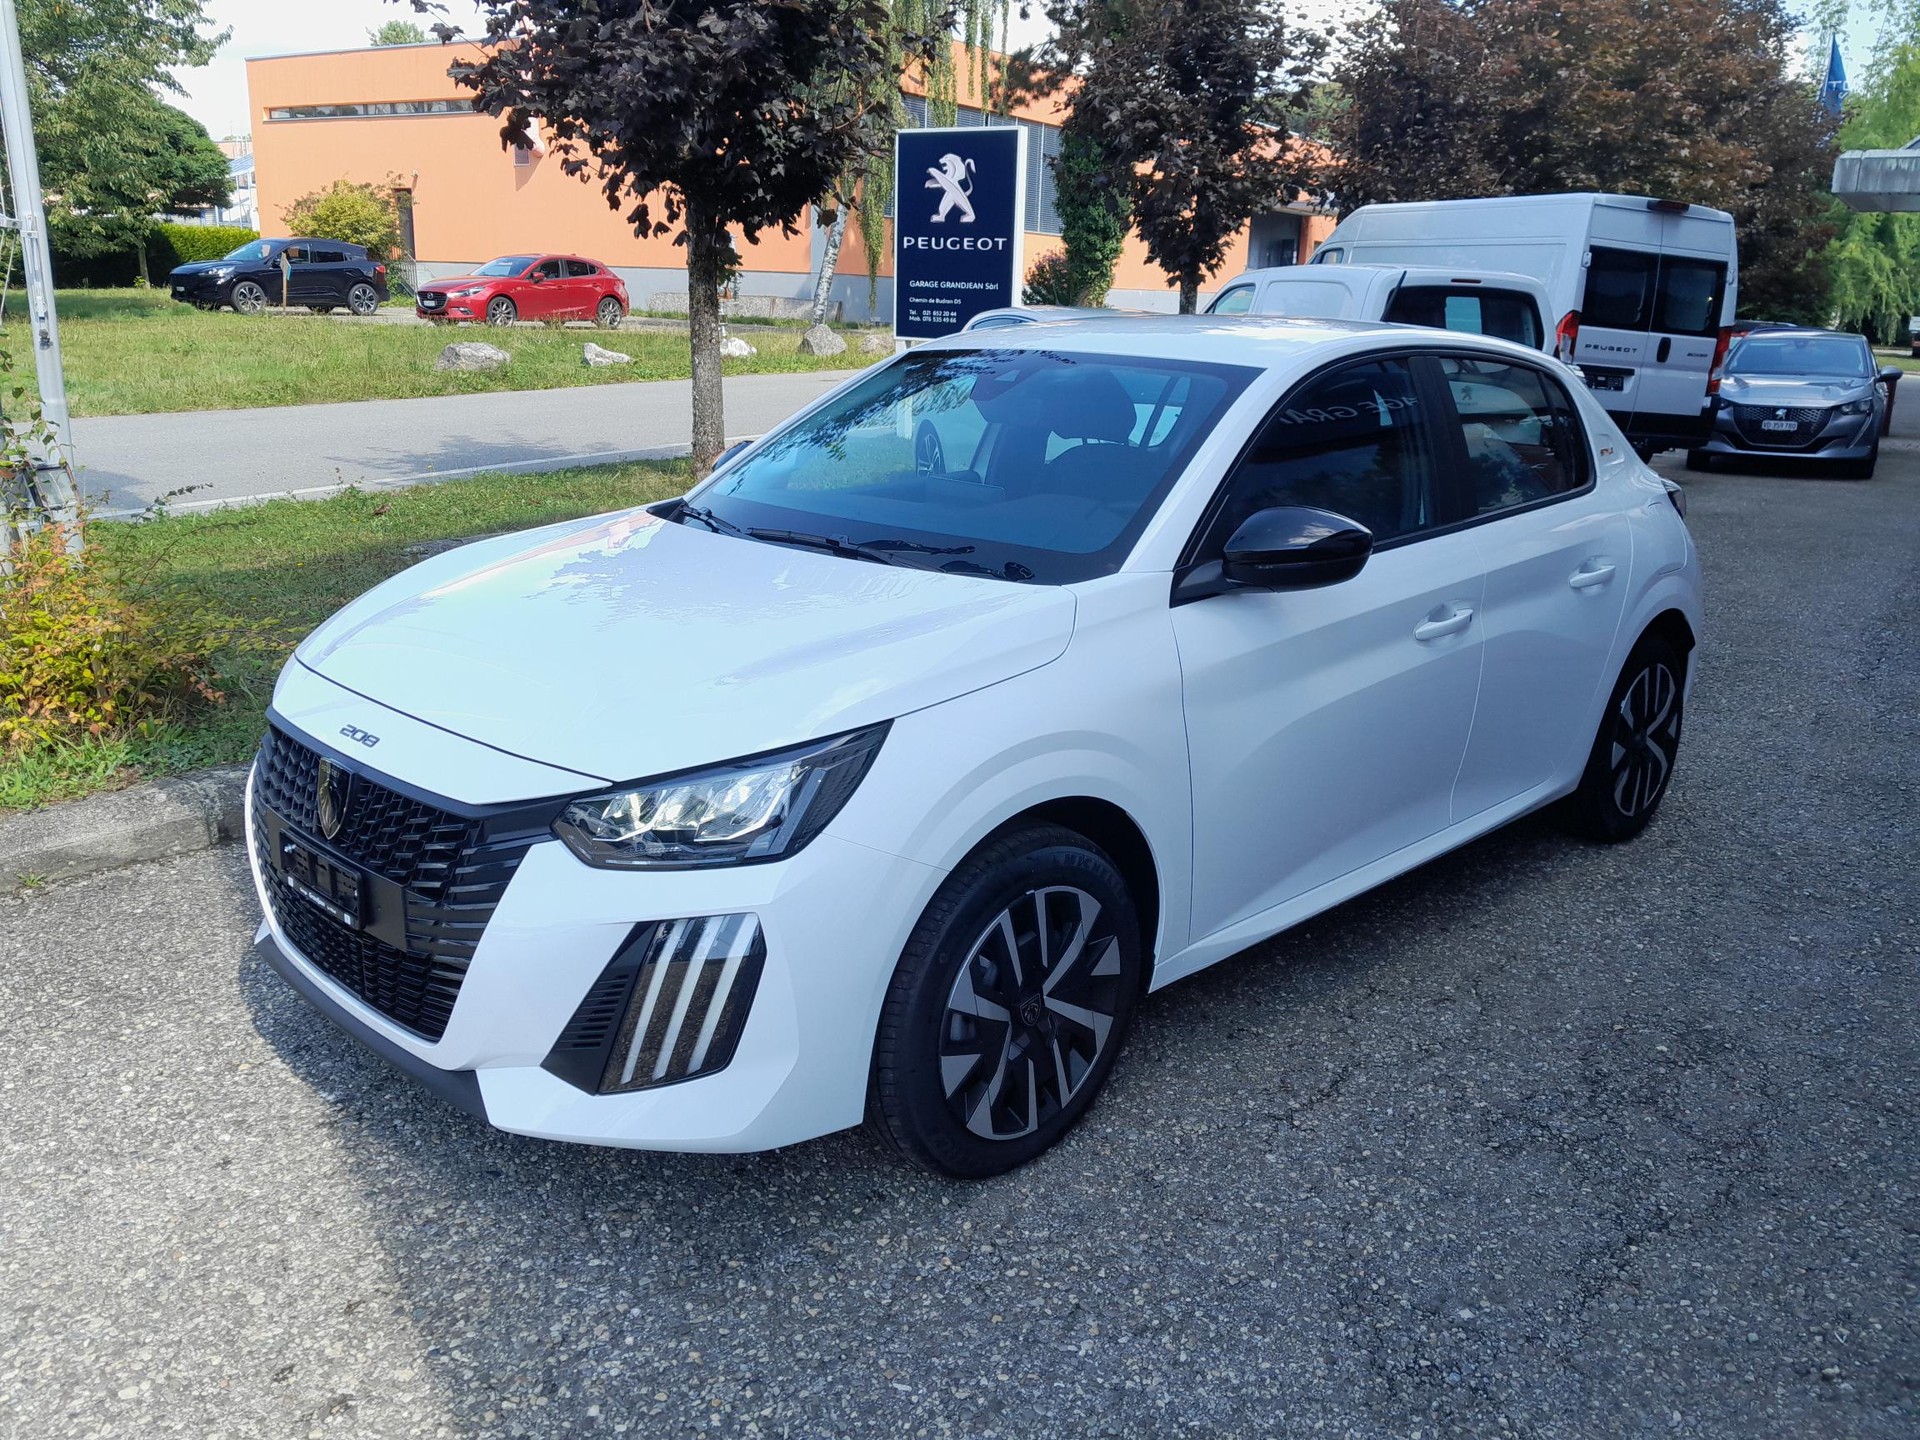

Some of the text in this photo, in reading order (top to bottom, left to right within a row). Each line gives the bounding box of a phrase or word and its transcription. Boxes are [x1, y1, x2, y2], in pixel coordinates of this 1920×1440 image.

[903, 236, 1008, 251] PEUGEOT
[909, 280, 939, 288] GARAGE
[940, 281, 984, 290] GRANDJEAN
[1584, 343, 1638, 353] PEUGEOT
[339, 724, 380, 748] 208
